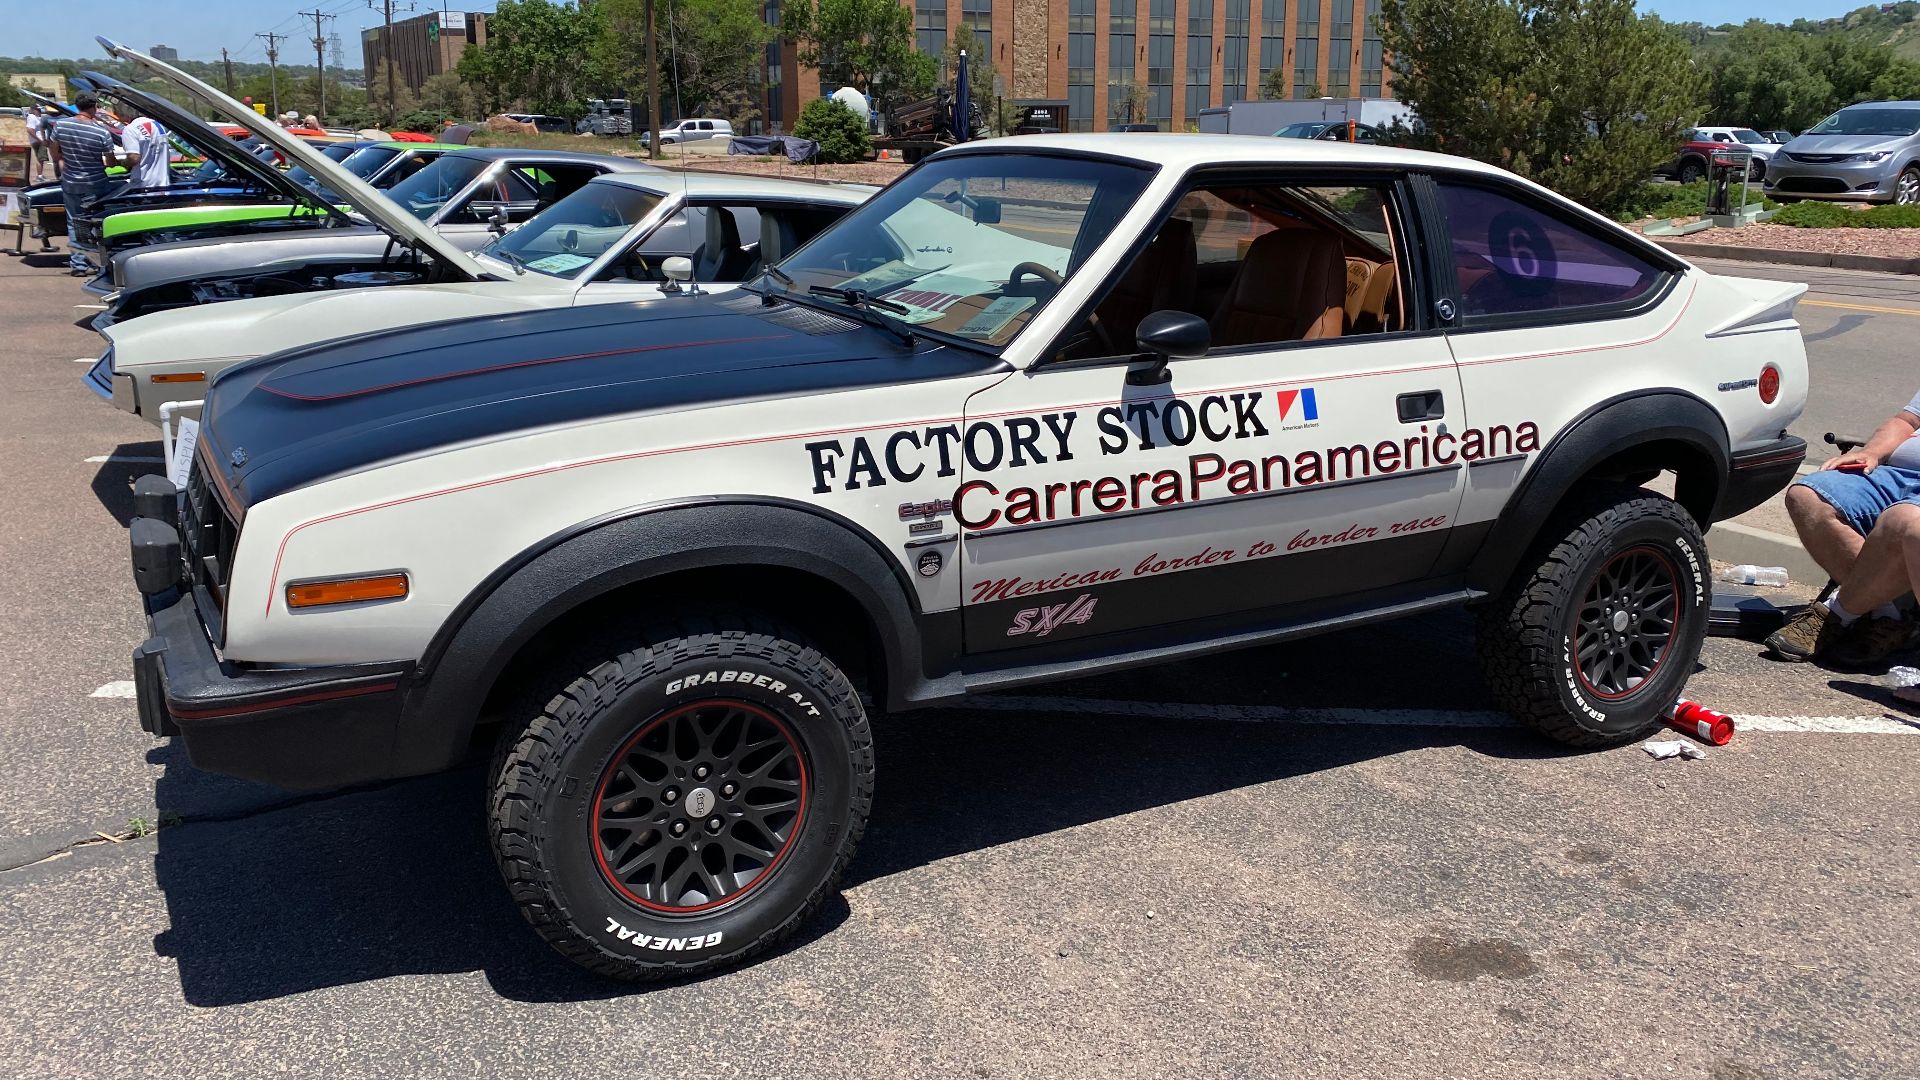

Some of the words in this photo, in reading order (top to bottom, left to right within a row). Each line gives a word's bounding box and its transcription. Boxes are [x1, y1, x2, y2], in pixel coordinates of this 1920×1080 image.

[1508, 227, 1540, 279] 6
[177, 427, 197, 487] DISPLAY
[805, 411, 1077, 494] FACTORY
[1097, 391, 1269, 455] STOCK
[898, 499, 952, 518] Eagle
[971, 567, 1122, 602] Mexican
[1133, 547, 1237, 576] border
[1246, 541, 1277, 558] to
[1287, 524, 1378, 551] border
[1390, 515, 1446, 534] race
[1675, 537, 1704, 606] GENERAL
[1006, 593, 1099, 637] SX/4
[665, 670, 788, 696] GRABBER
[787, 692, 821, 717] A/T
[1565, 667, 1606, 722] GRABBER
[605, 916, 723, 951] GENERAL
